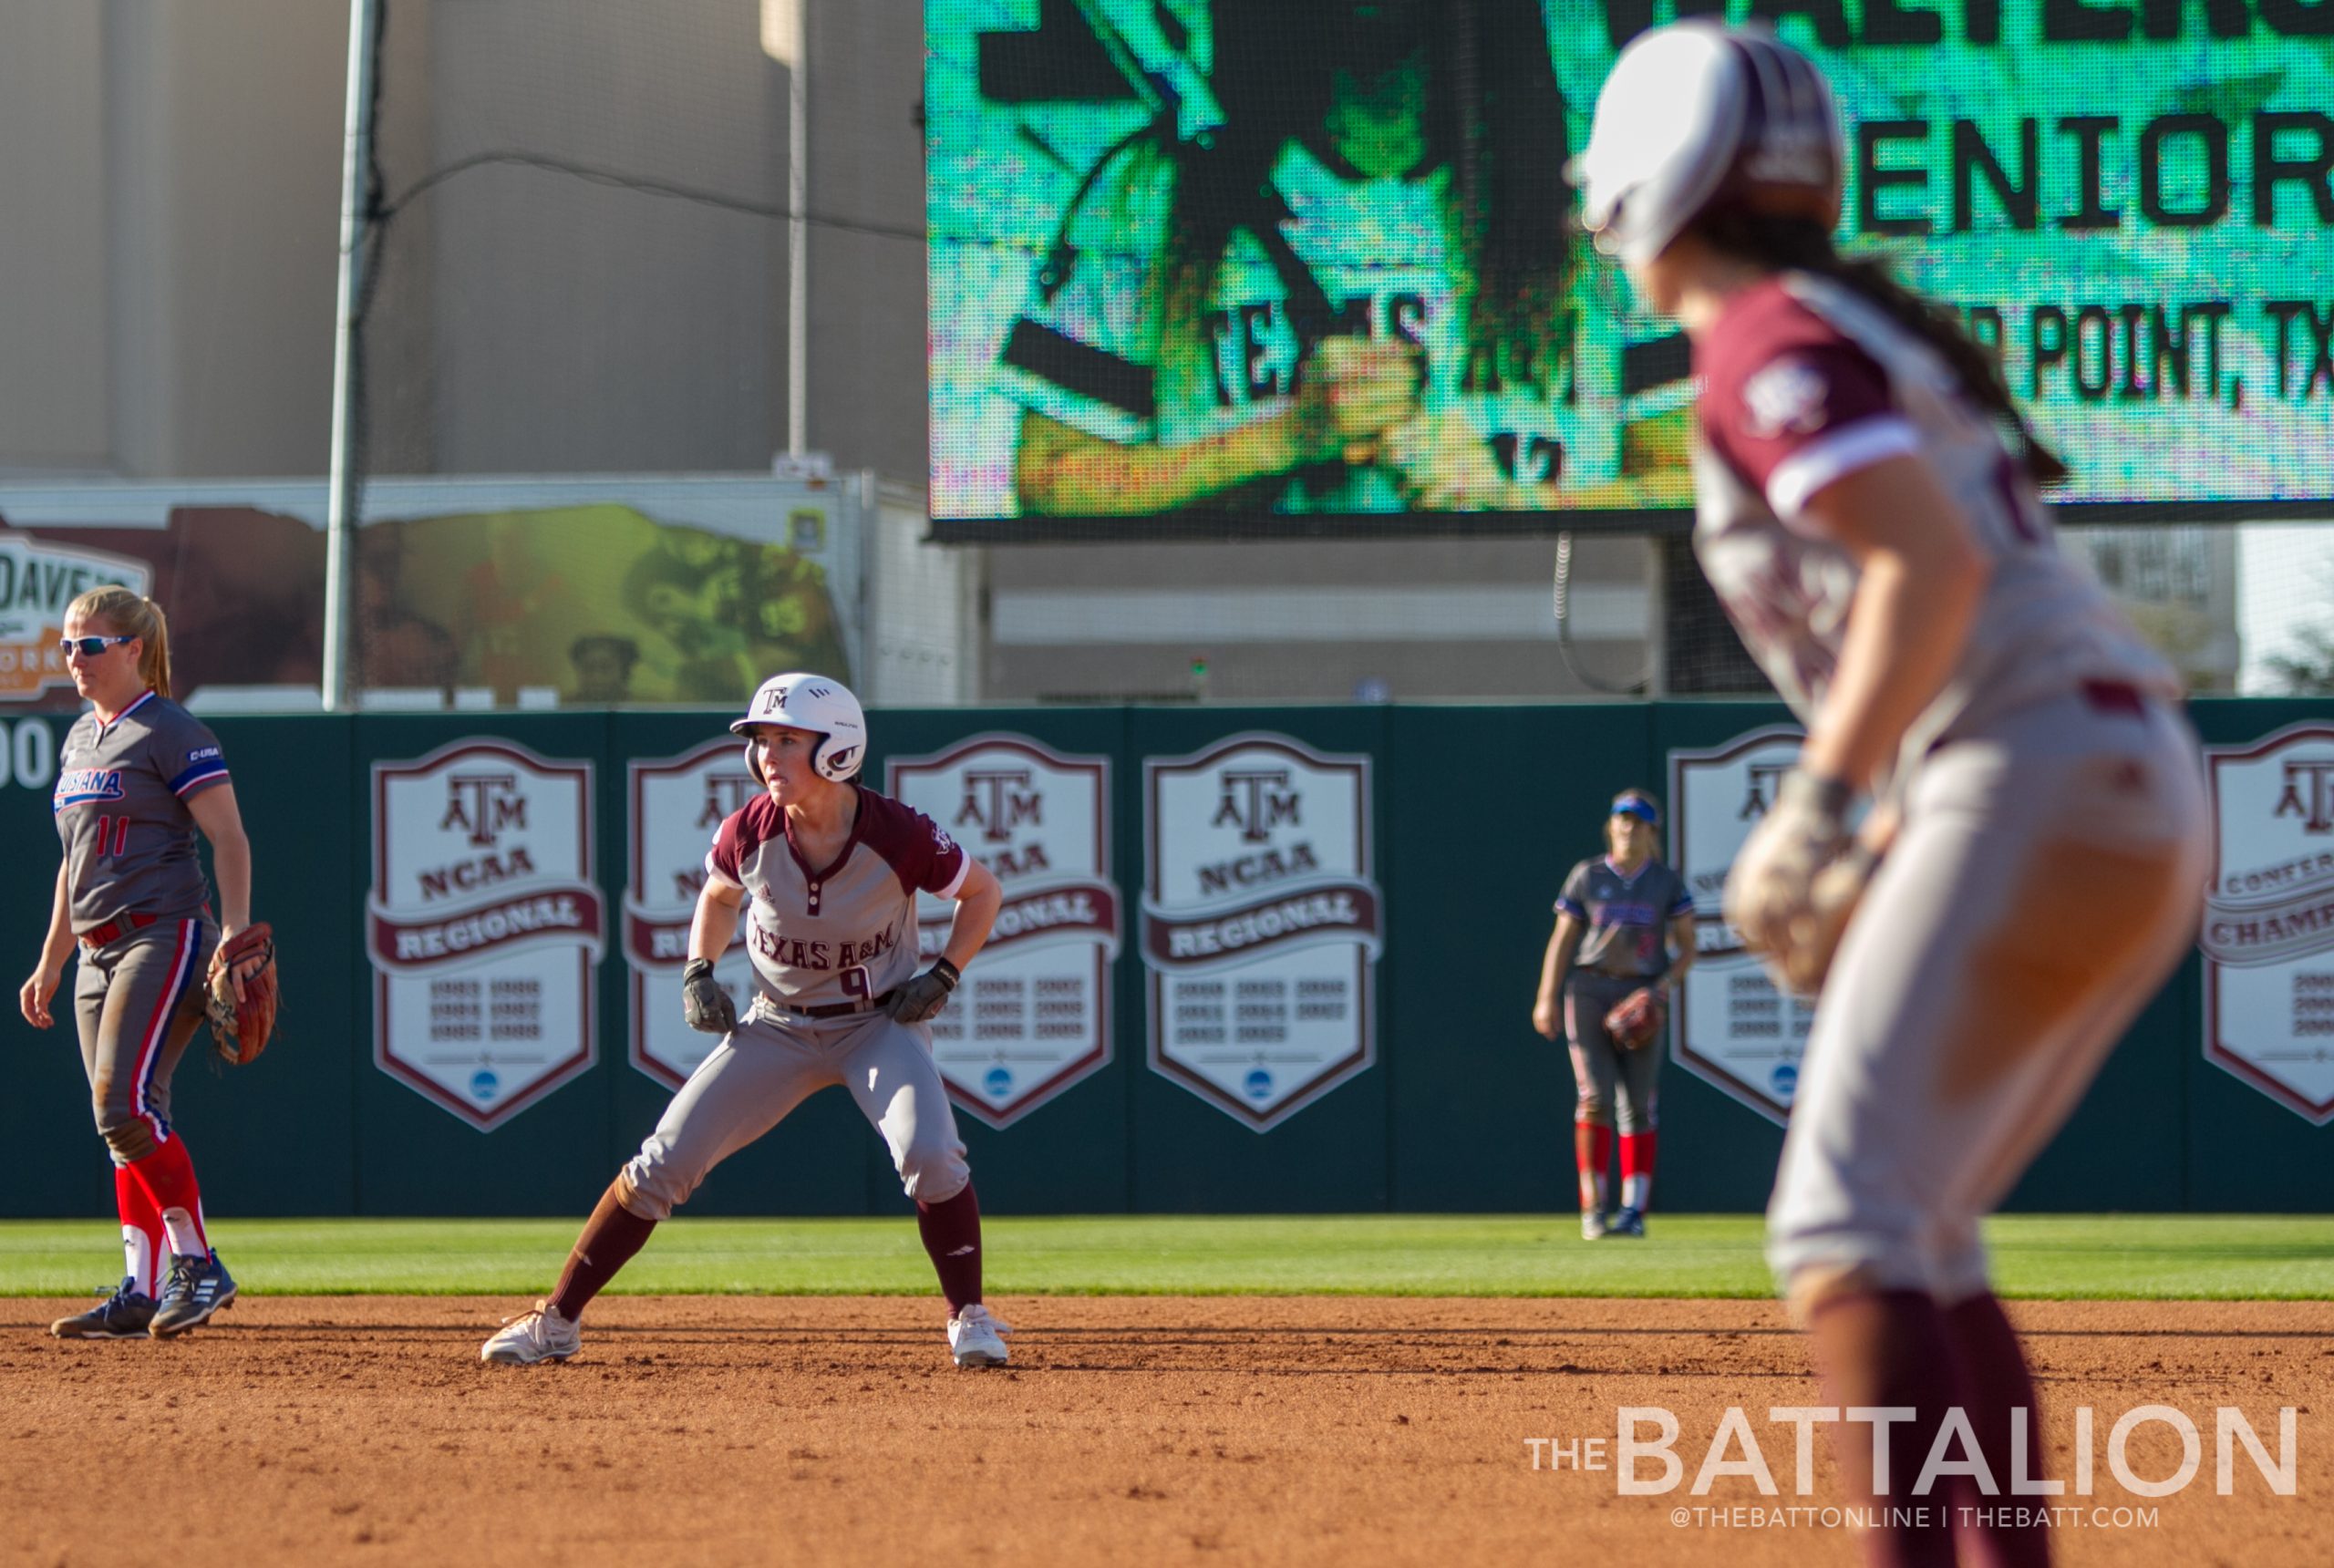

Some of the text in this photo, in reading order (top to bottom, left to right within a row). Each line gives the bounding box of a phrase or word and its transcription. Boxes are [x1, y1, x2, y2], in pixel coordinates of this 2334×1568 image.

[1861, 111, 2334, 235] ENIOR
[2034, 302, 2242, 411] POINT,
[96, 815, 129, 857] 11
[418, 848, 535, 902] NCAA
[1196, 841, 1319, 896] NCAA
[395, 895, 584, 962] REGIONAL
[753, 913, 831, 970] TEXAS
[837, 921, 893, 969] A&M
[918, 893, 1098, 956] REONAL
[1169, 892, 1358, 958] REGIONAL
[840, 964, 873, 1004] 9
